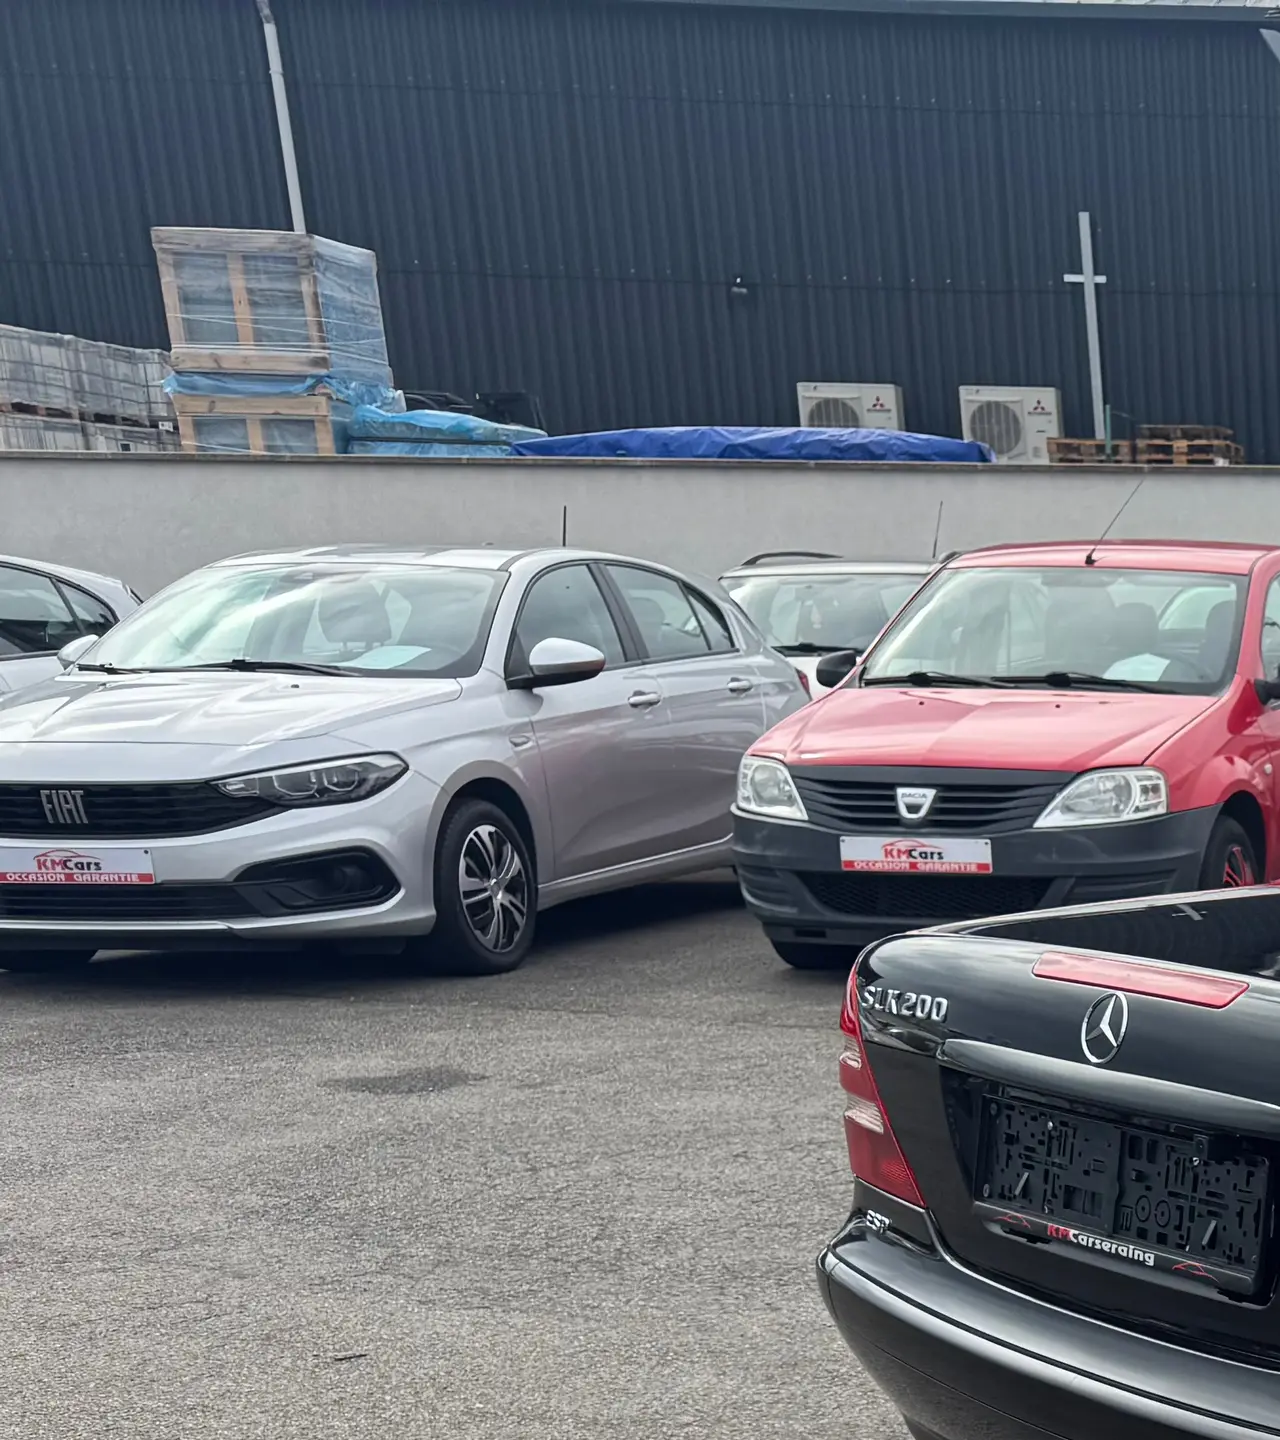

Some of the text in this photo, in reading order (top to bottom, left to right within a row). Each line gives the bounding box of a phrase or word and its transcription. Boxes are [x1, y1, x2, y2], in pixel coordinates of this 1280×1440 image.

[40, 790, 89, 824] FIAT
[854, 861, 978, 872] OCCASION GARANTIE
[6, 873, 140, 882] OCCASION GARANTIE
